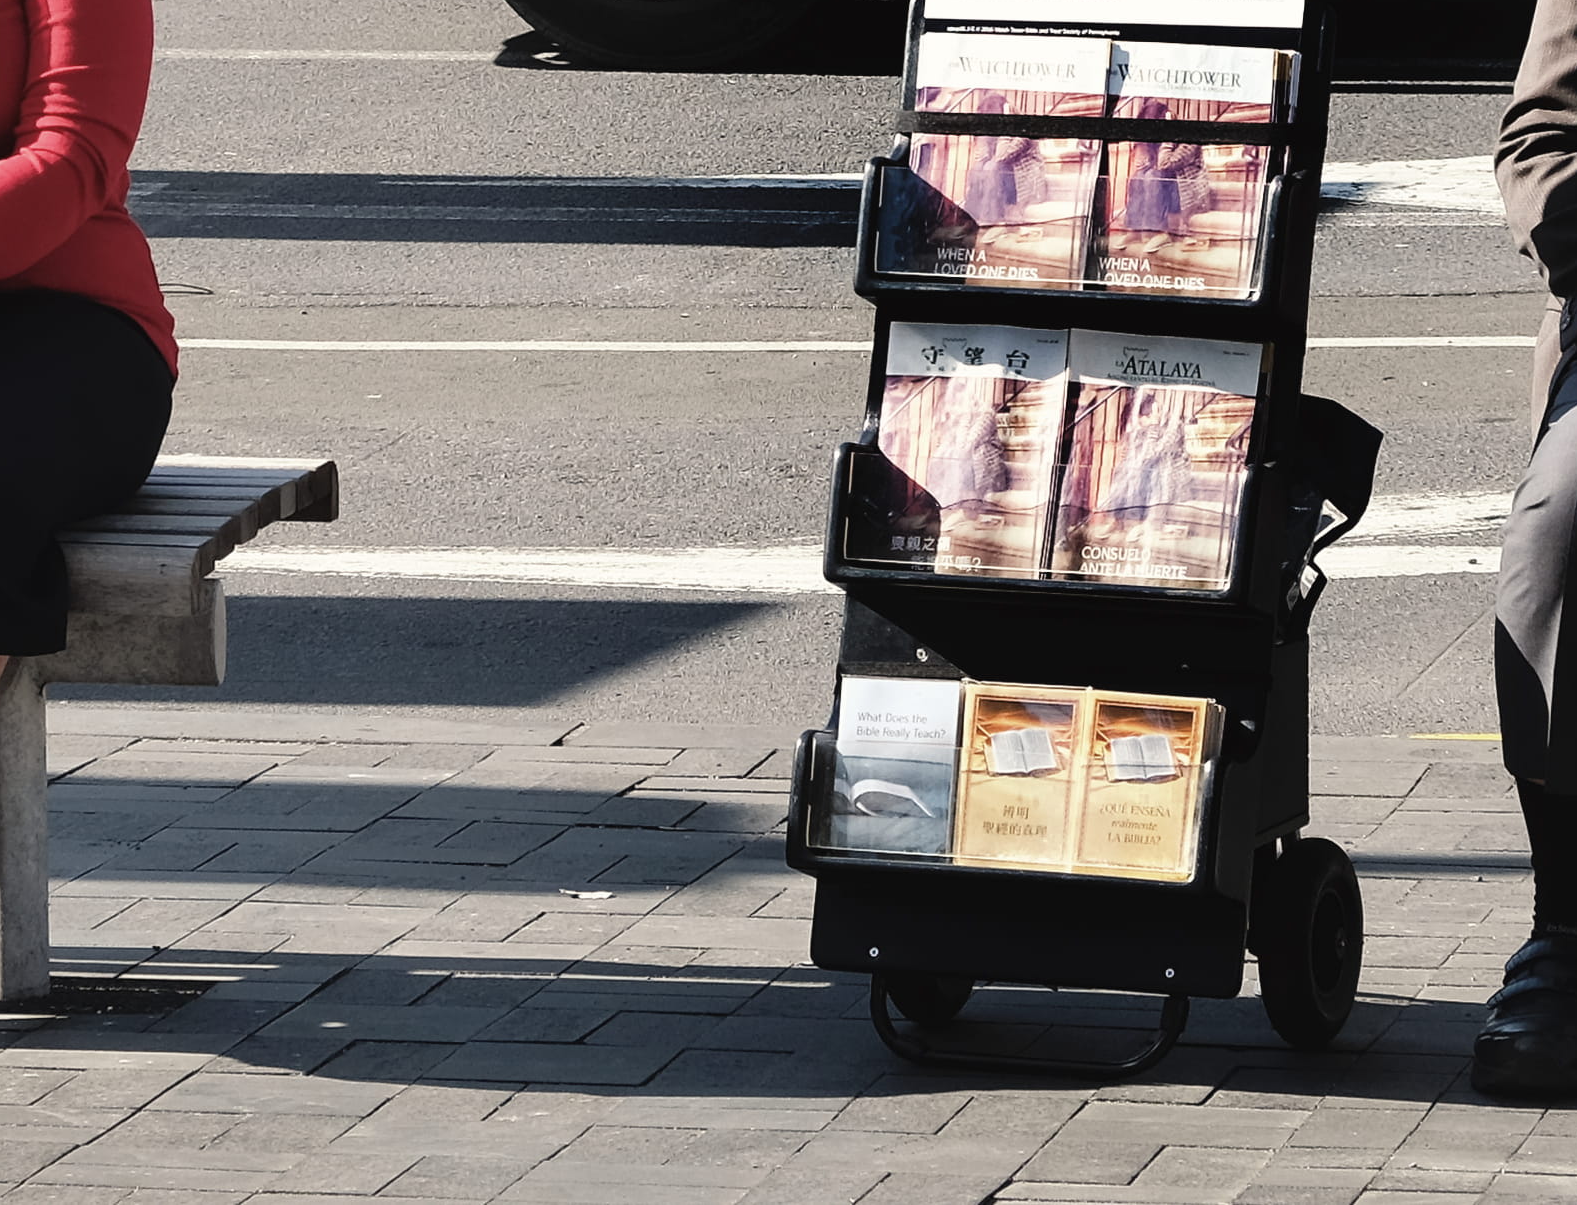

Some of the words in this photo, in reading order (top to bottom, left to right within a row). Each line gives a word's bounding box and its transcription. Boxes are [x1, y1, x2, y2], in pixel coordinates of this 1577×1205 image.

[959, 56, 1076, 79] WATCHTOWER
[1117, 63, 1242, 88] WATCHTOWER
[937, 247, 975, 262] WHEN
[976, 249, 987, 262] A
[934, 262, 977, 276] LOVED
[978, 264, 1006, 278] ONE
[1007, 266, 1039, 279] DIES
[1099, 257, 1138, 271] WHEN
[1139, 258, 1151, 272] A
[1143, 274, 1172, 288] ONE
[1174, 276, 1206, 290] DIES
[1123, 355, 1202, 379] ATALAYA
[1081, 545, 1152, 562] CONSUELO
[1079, 562, 1113, 576] ANTE
[1115, 563, 1133, 577] LA
[857, 712, 882, 723] What
[885, 712, 909, 724] Does
[912, 713, 928, 724] the
[856, 725, 880, 737] Bible
[882, 726, 911, 740] Really
[914, 727, 947, 739] Teach?
[1130, 803, 1171, 818] ENSEÑA
[1107, 832, 1121, 843] LA
